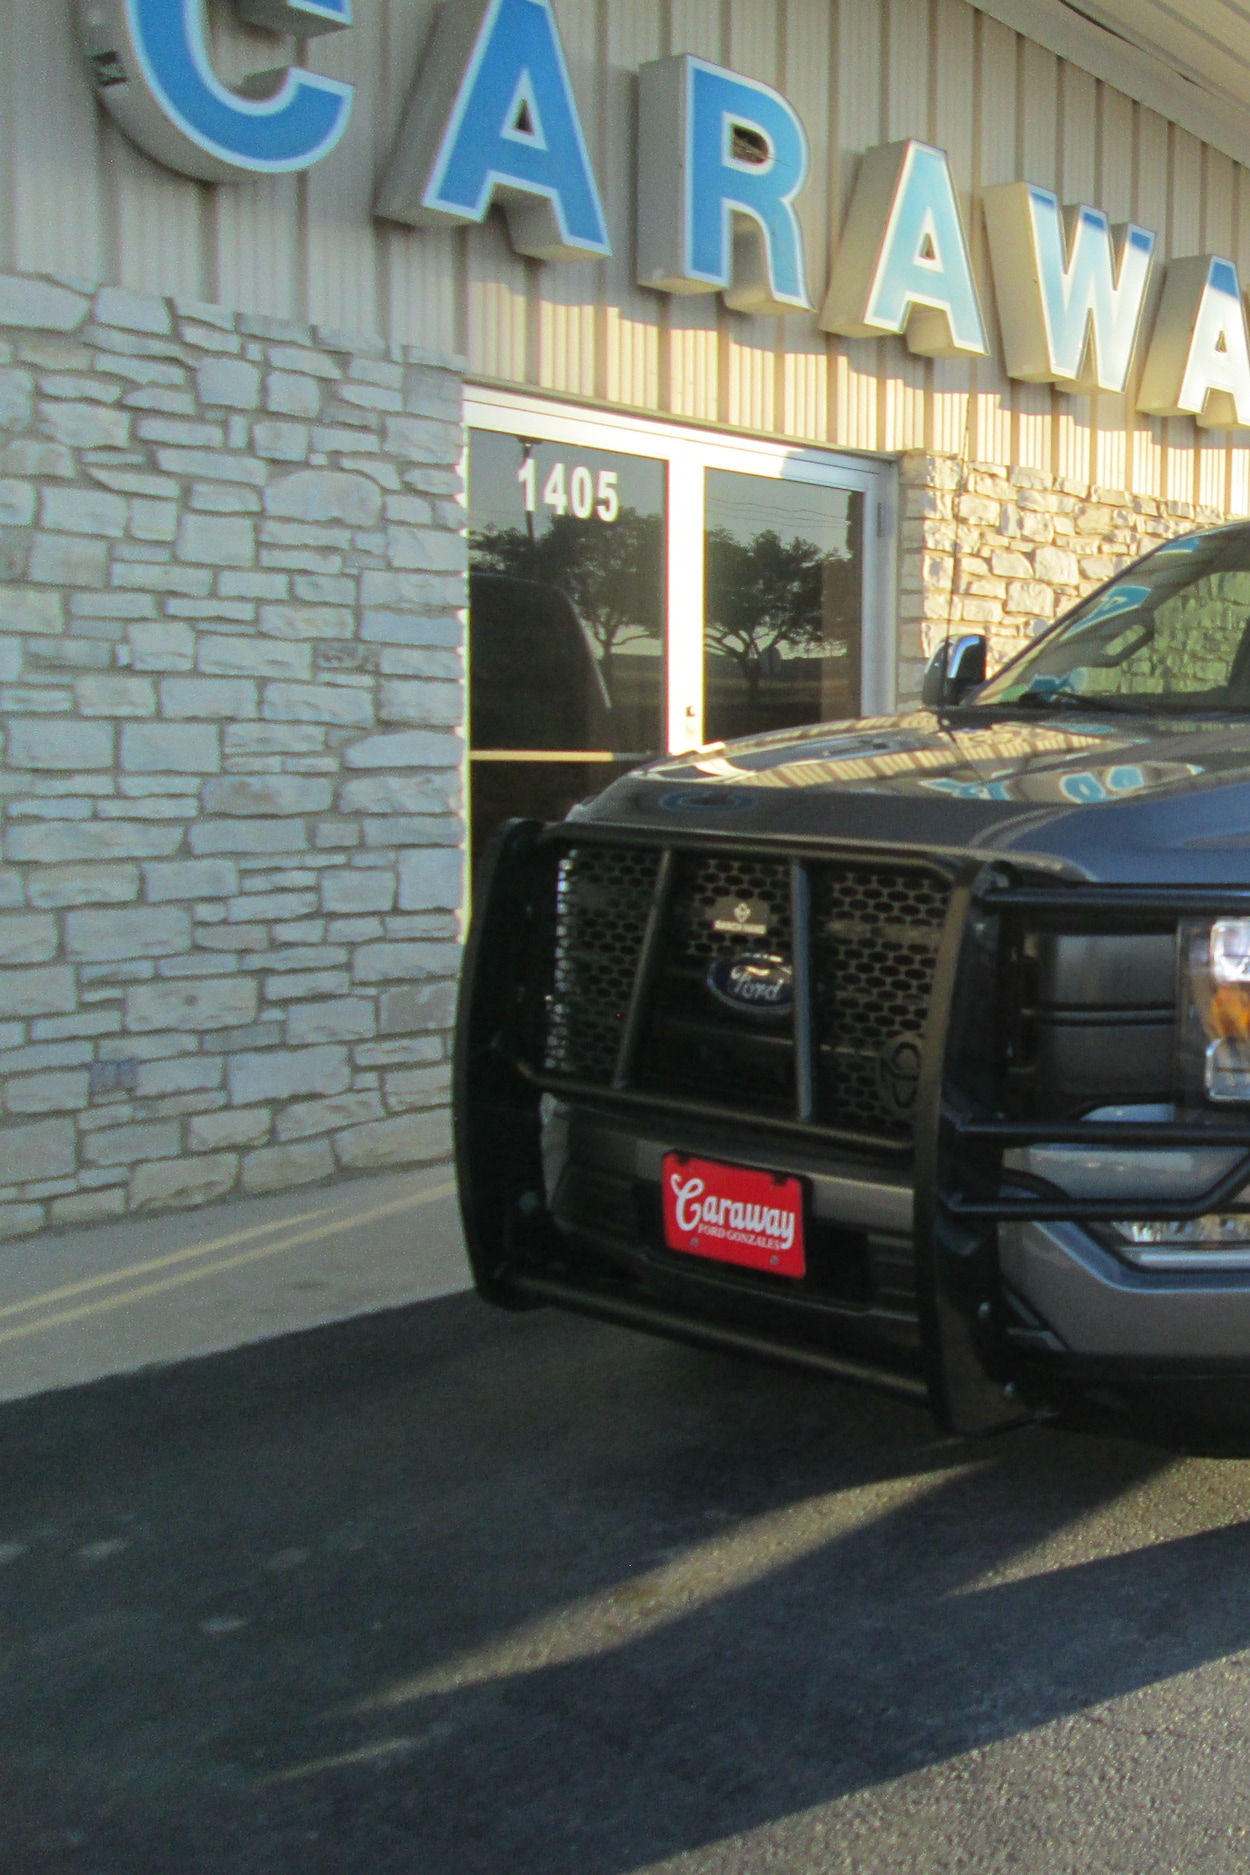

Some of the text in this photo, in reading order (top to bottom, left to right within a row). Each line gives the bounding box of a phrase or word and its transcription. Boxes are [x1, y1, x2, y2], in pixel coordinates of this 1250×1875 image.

[517, 458, 619, 522] 1405
[730, 964, 785, 1000] Ford
[669, 1173, 796, 1250] Caraway
[697, 1223, 783, 1251] FORD GONZALES
